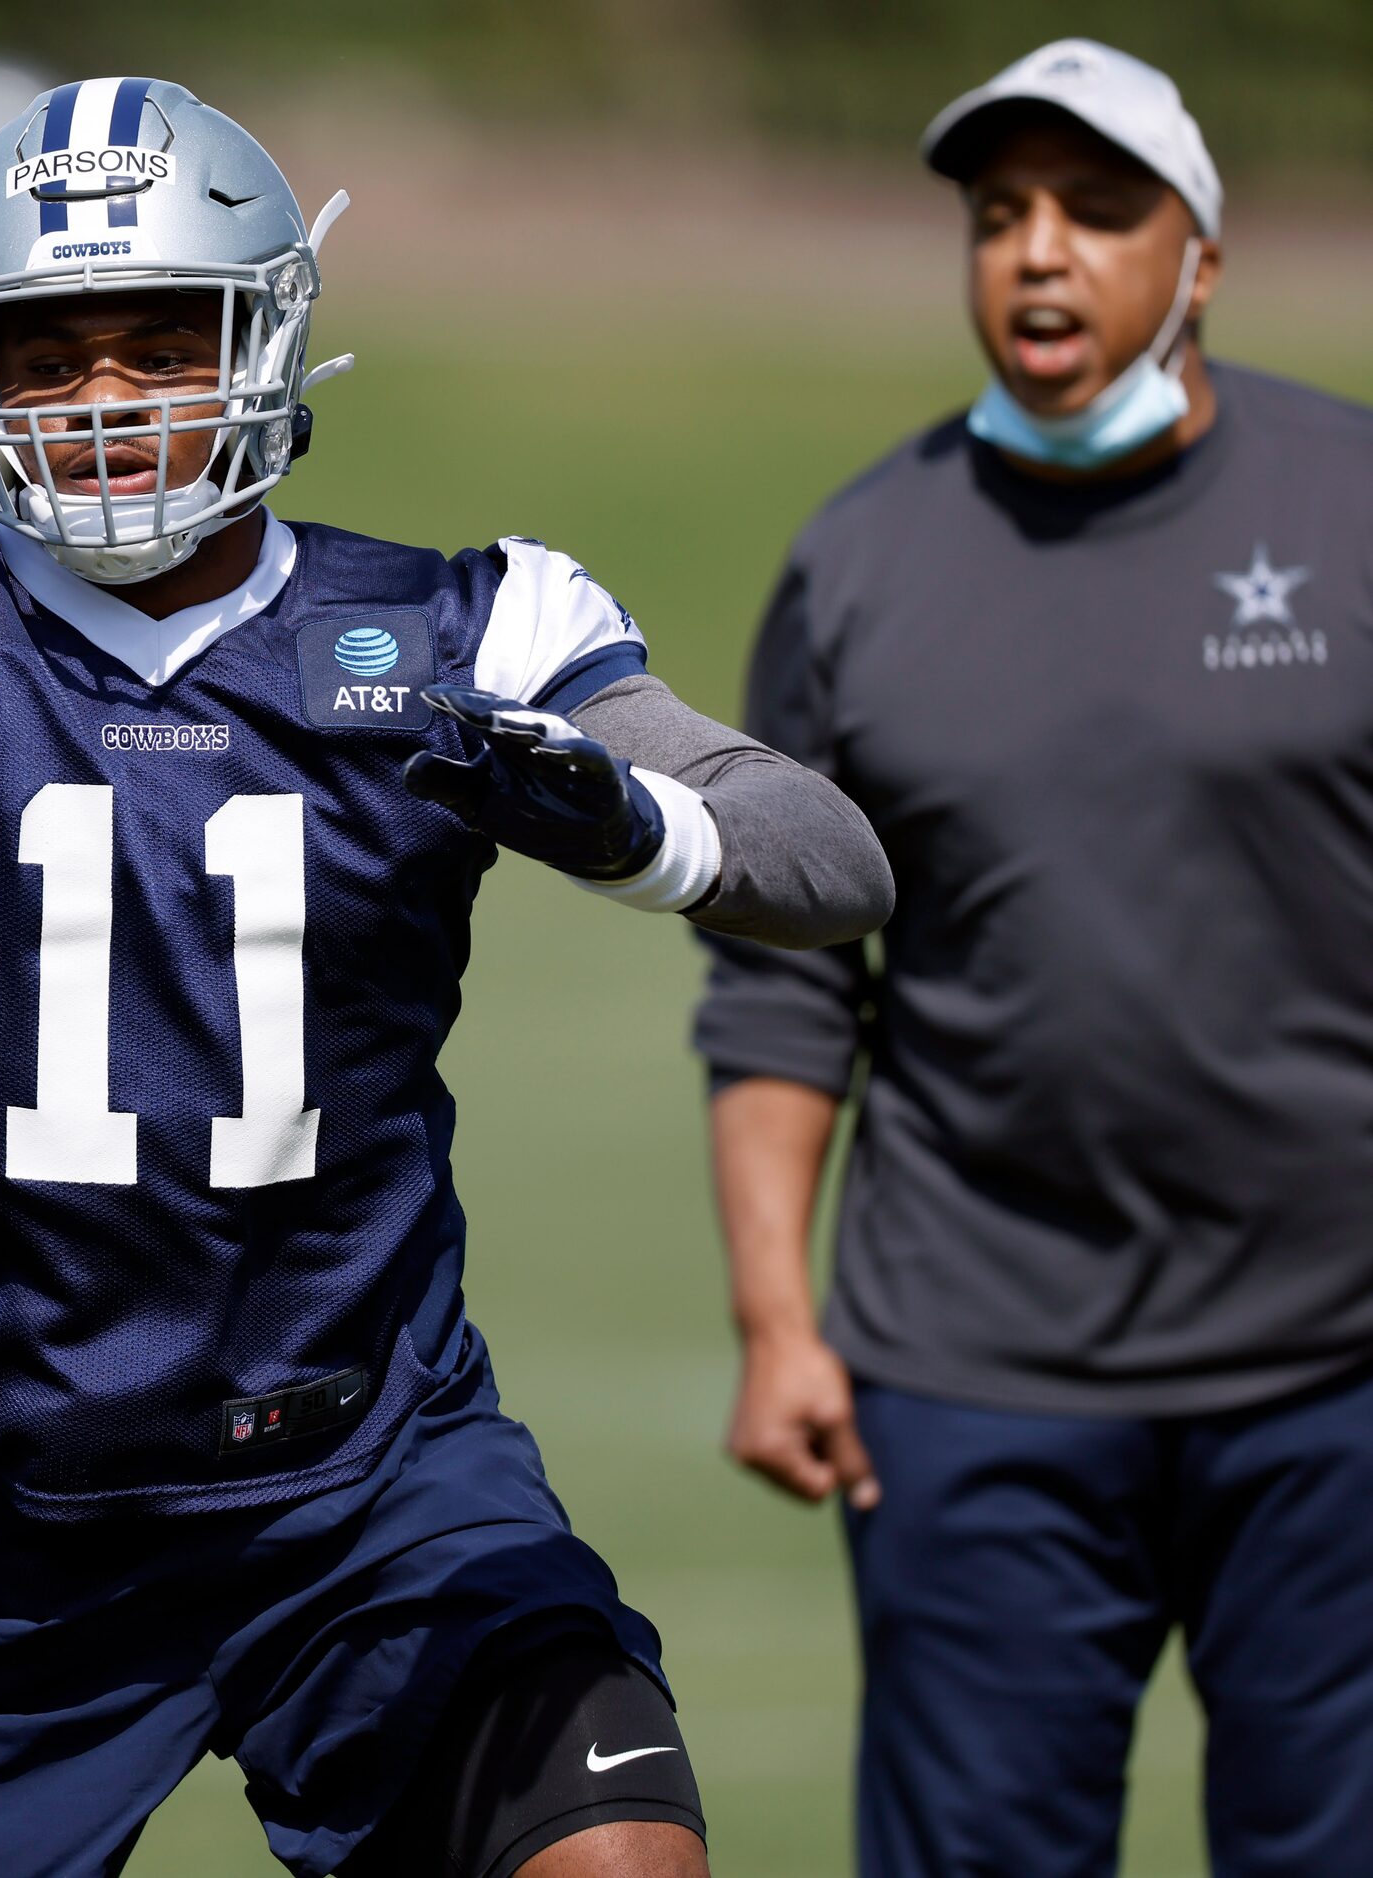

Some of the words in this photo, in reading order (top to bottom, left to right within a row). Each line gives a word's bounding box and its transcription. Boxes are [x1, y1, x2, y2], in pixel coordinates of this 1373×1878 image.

[13, 149, 169, 190] PARSONS
[52, 240, 132, 260] COWBOYS
[332, 686, 411, 713] AT&T
[101, 724, 230, 751] COWBOYS
[5, 782, 321, 1189] 11
[234, 1423, 252, 1439] NFL
